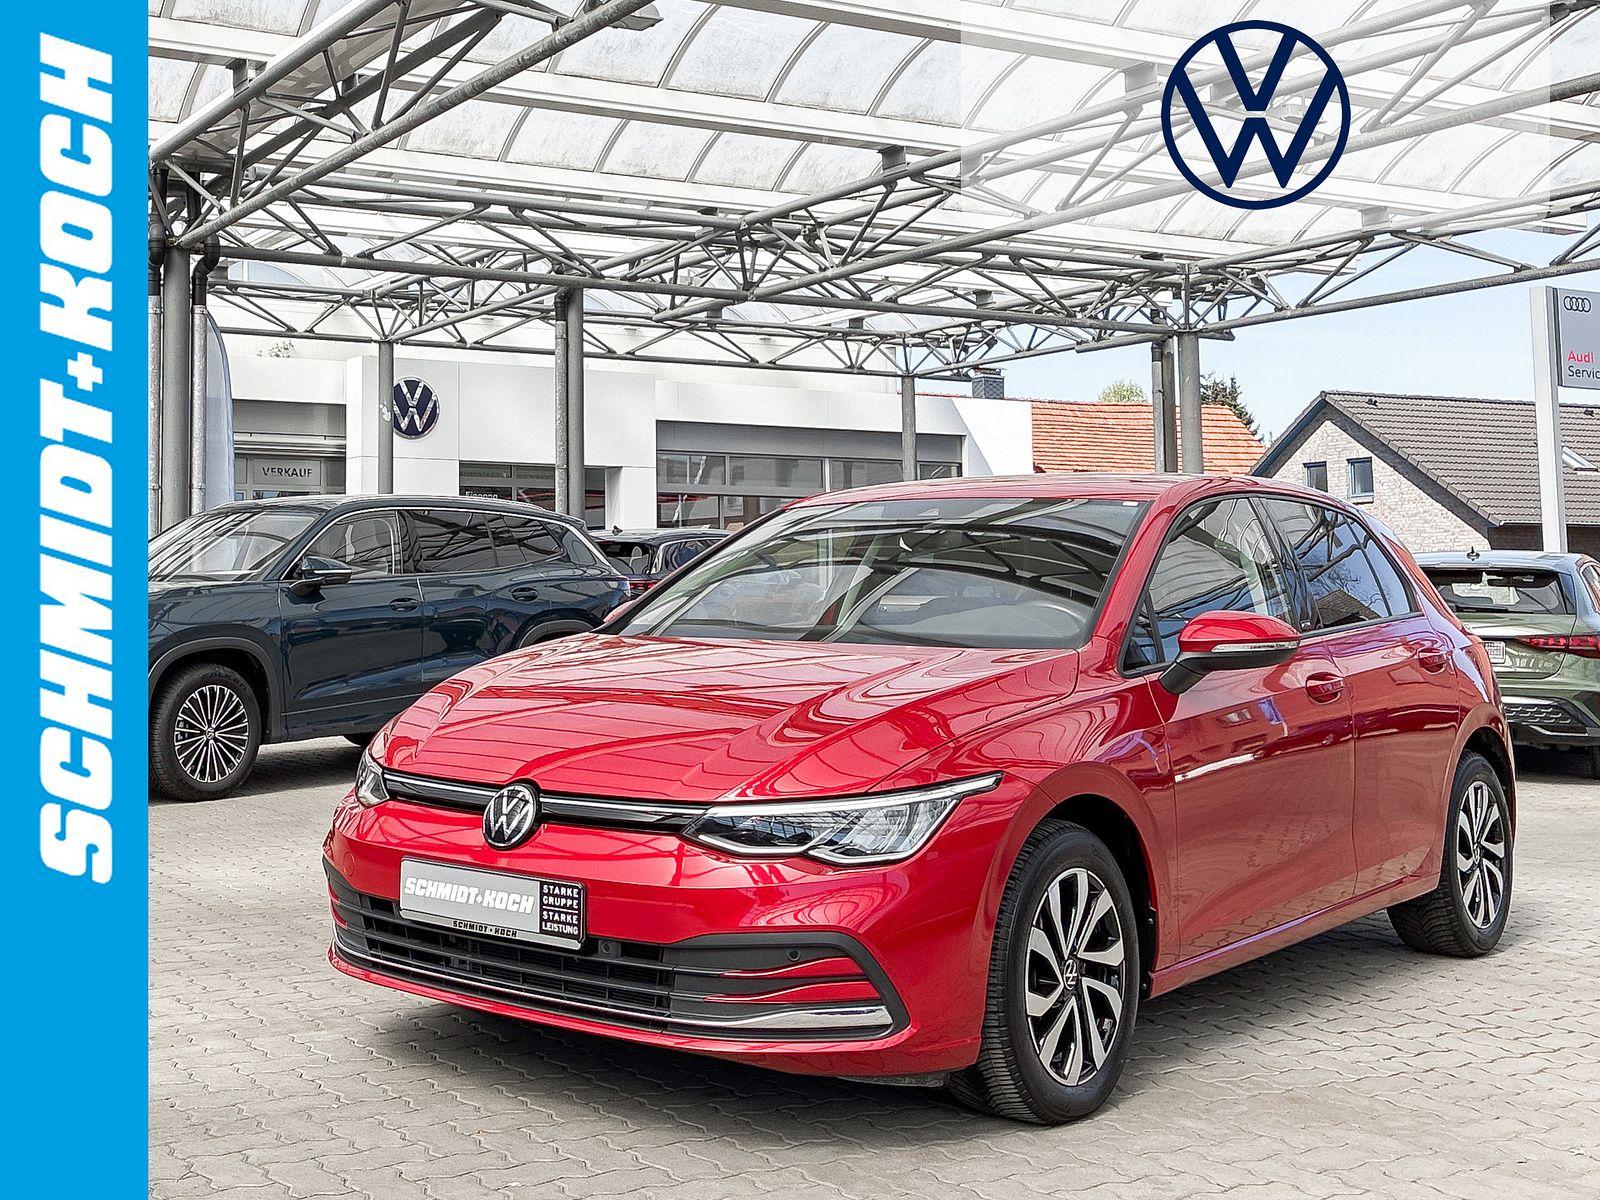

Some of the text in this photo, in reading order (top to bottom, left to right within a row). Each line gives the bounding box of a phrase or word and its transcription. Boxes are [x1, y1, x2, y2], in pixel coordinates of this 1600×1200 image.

[1567, 351, 1594, 363] Audi
[261, 466, 313, 478] VERKAUF
[543, 884, 579, 898] STARKE
[543, 895, 579, 909] GRUPPE
[543, 911, 579, 924] STARKE
[542, 921, 579, 935] LEISTUNG
